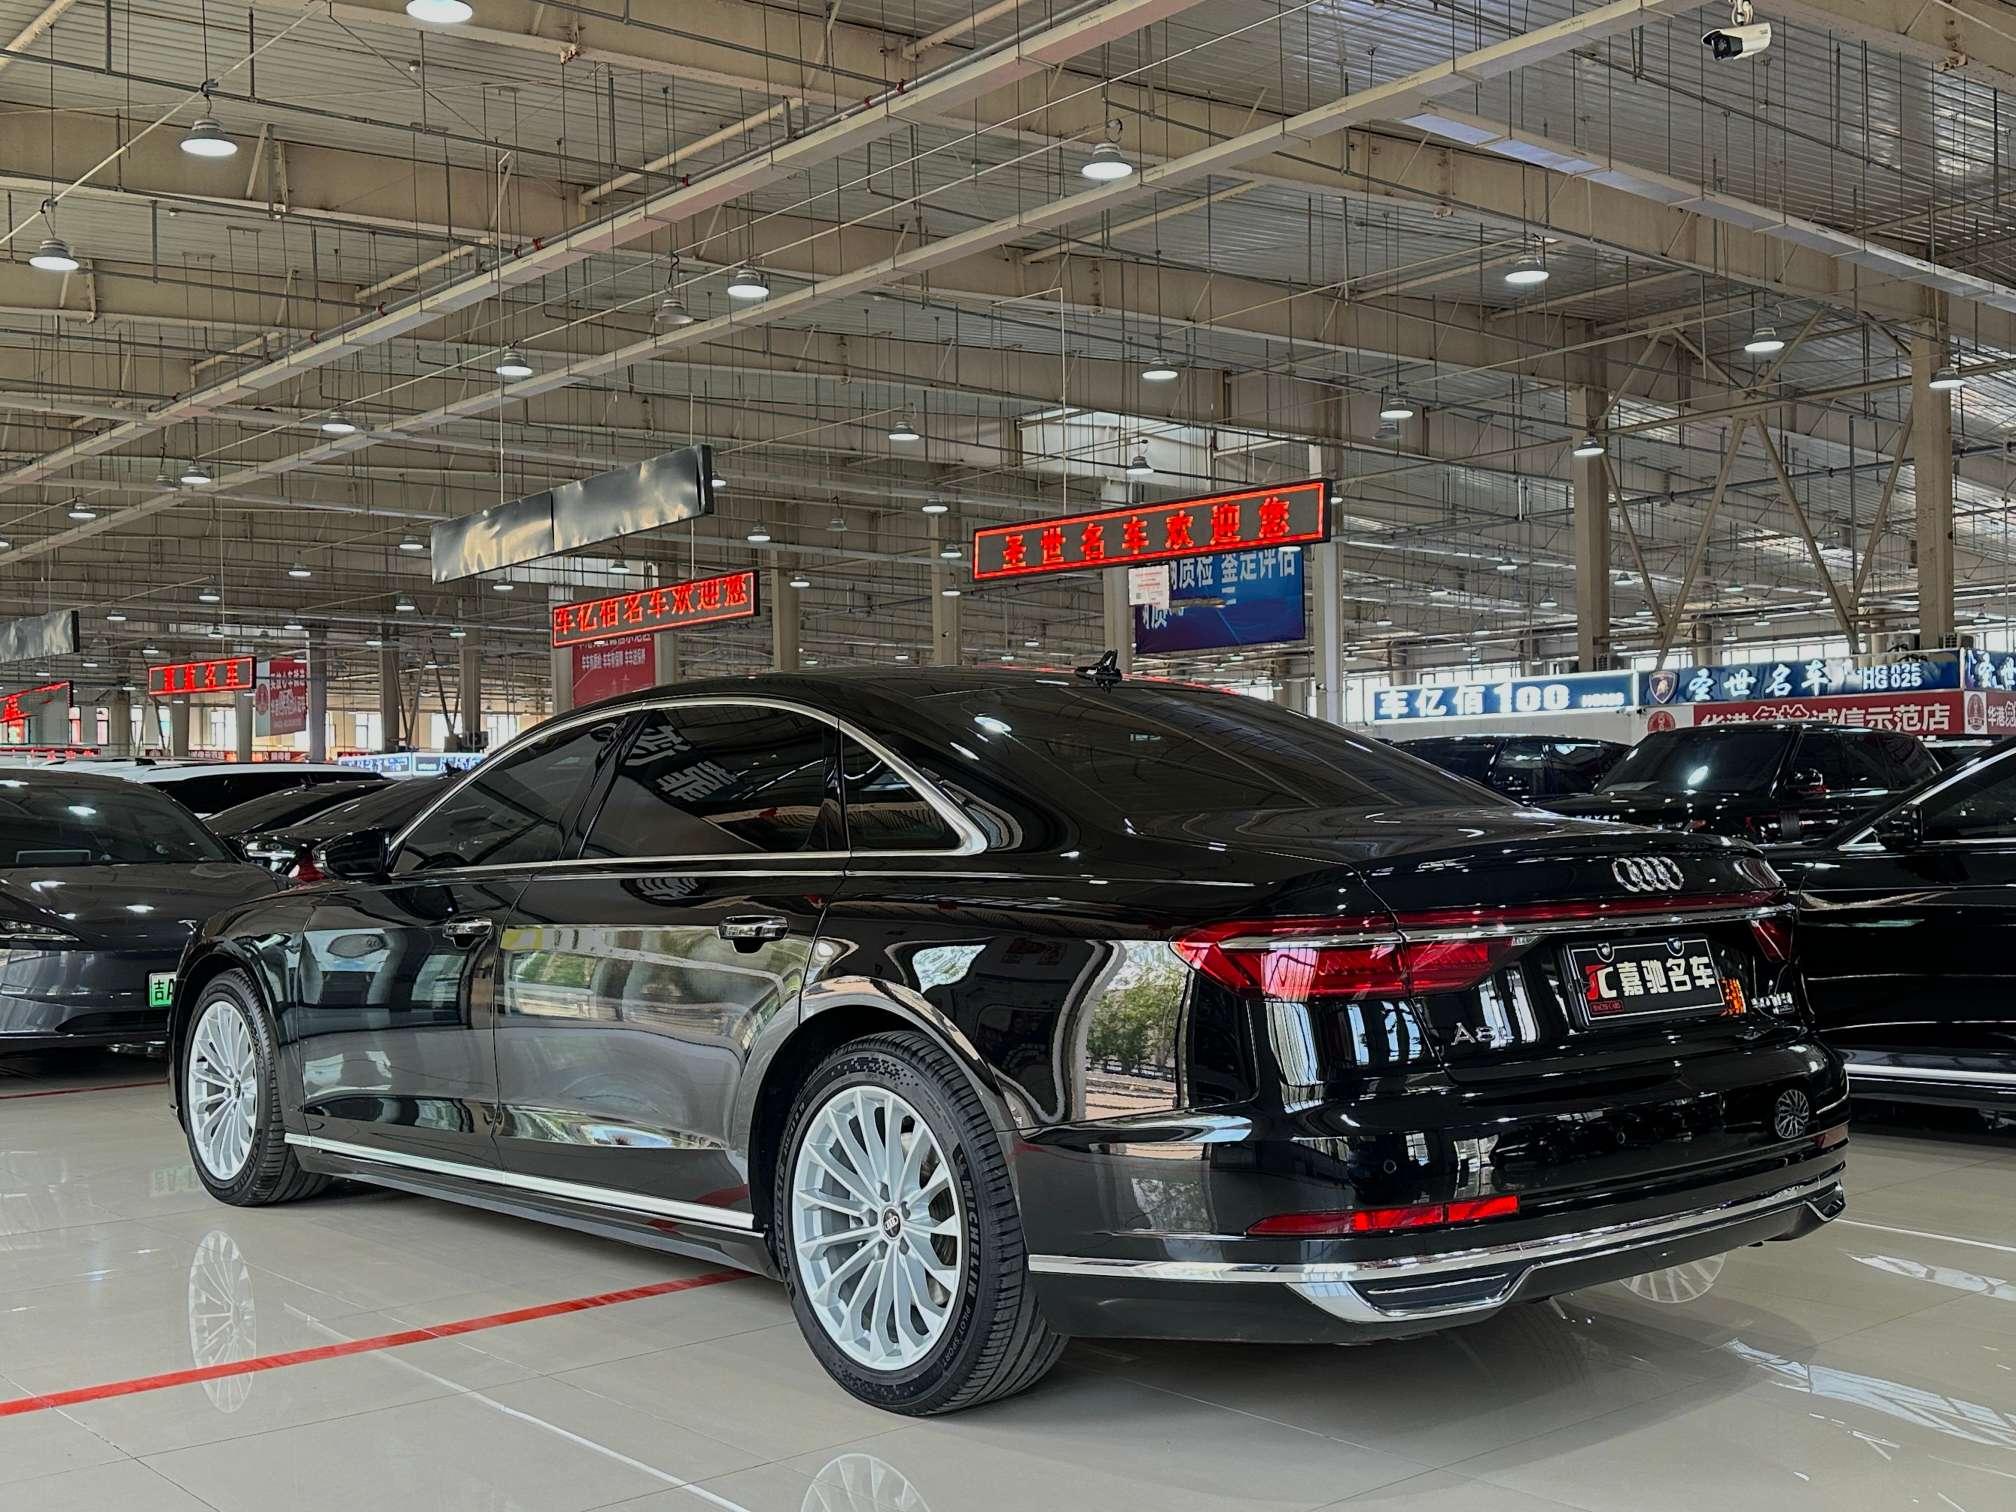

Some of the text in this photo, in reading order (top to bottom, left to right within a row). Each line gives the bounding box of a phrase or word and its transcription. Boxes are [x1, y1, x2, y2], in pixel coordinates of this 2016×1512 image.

[1002, 497, 1290, 569] 圣世名车欢迎您
[1688, 659, 1830, 701] 圣世名车
[961, 1180, 980, 1298] MICHELIN
